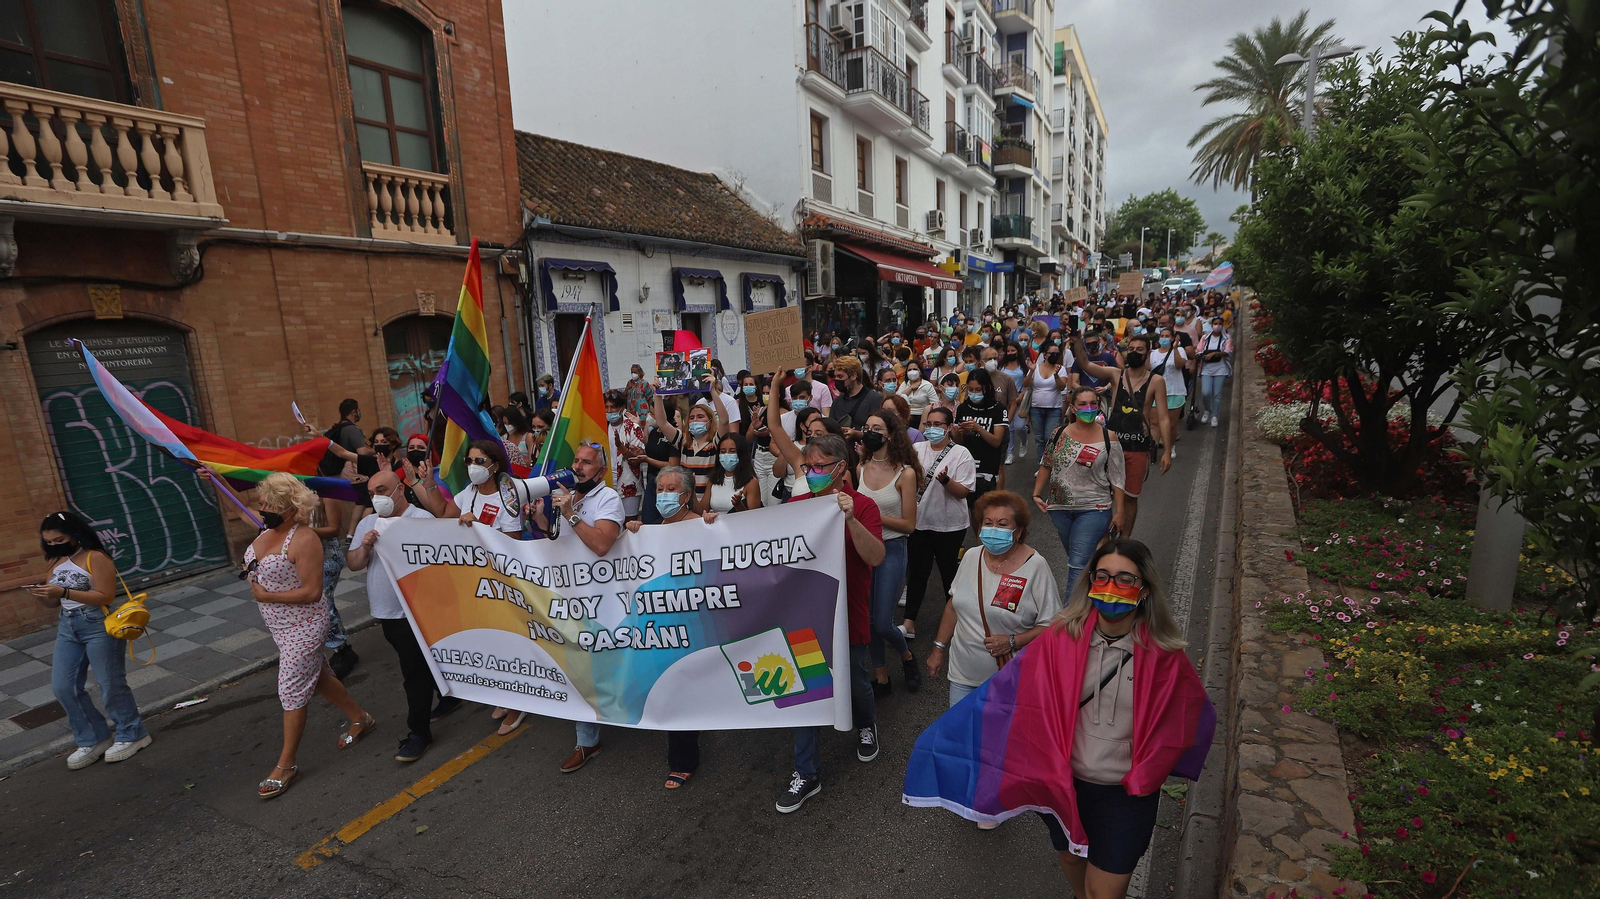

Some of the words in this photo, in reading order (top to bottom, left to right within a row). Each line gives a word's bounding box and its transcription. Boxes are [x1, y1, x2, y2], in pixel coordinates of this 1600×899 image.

[48, 340, 61, 348] LE
[64, 338, 113, 348] SUIMOS
[116, 335, 170, 345] ATENDIENDO
[758, 328, 790, 348] PARA
[72, 348, 122, 358] GGORIO
[753, 345, 802, 366] SAMUEL!
[1116, 431, 1147, 443] weety
[402, 544, 488, 568] TRANS
[486, 550, 550, 589] MARI
[573, 555, 656, 586] BOLLOS
[670, 550, 703, 577] EN
[721, 535, 818, 572] LUCHA
[549, 594, 603, 621] HOY
[617, 592, 632, 615] Y
[632, 584, 742, 616] SIEMPRE
[528, 620, 566, 645] ¡NO
[430, 648, 484, 668] ALEAS
[486, 655, 567, 685] Andalucía
